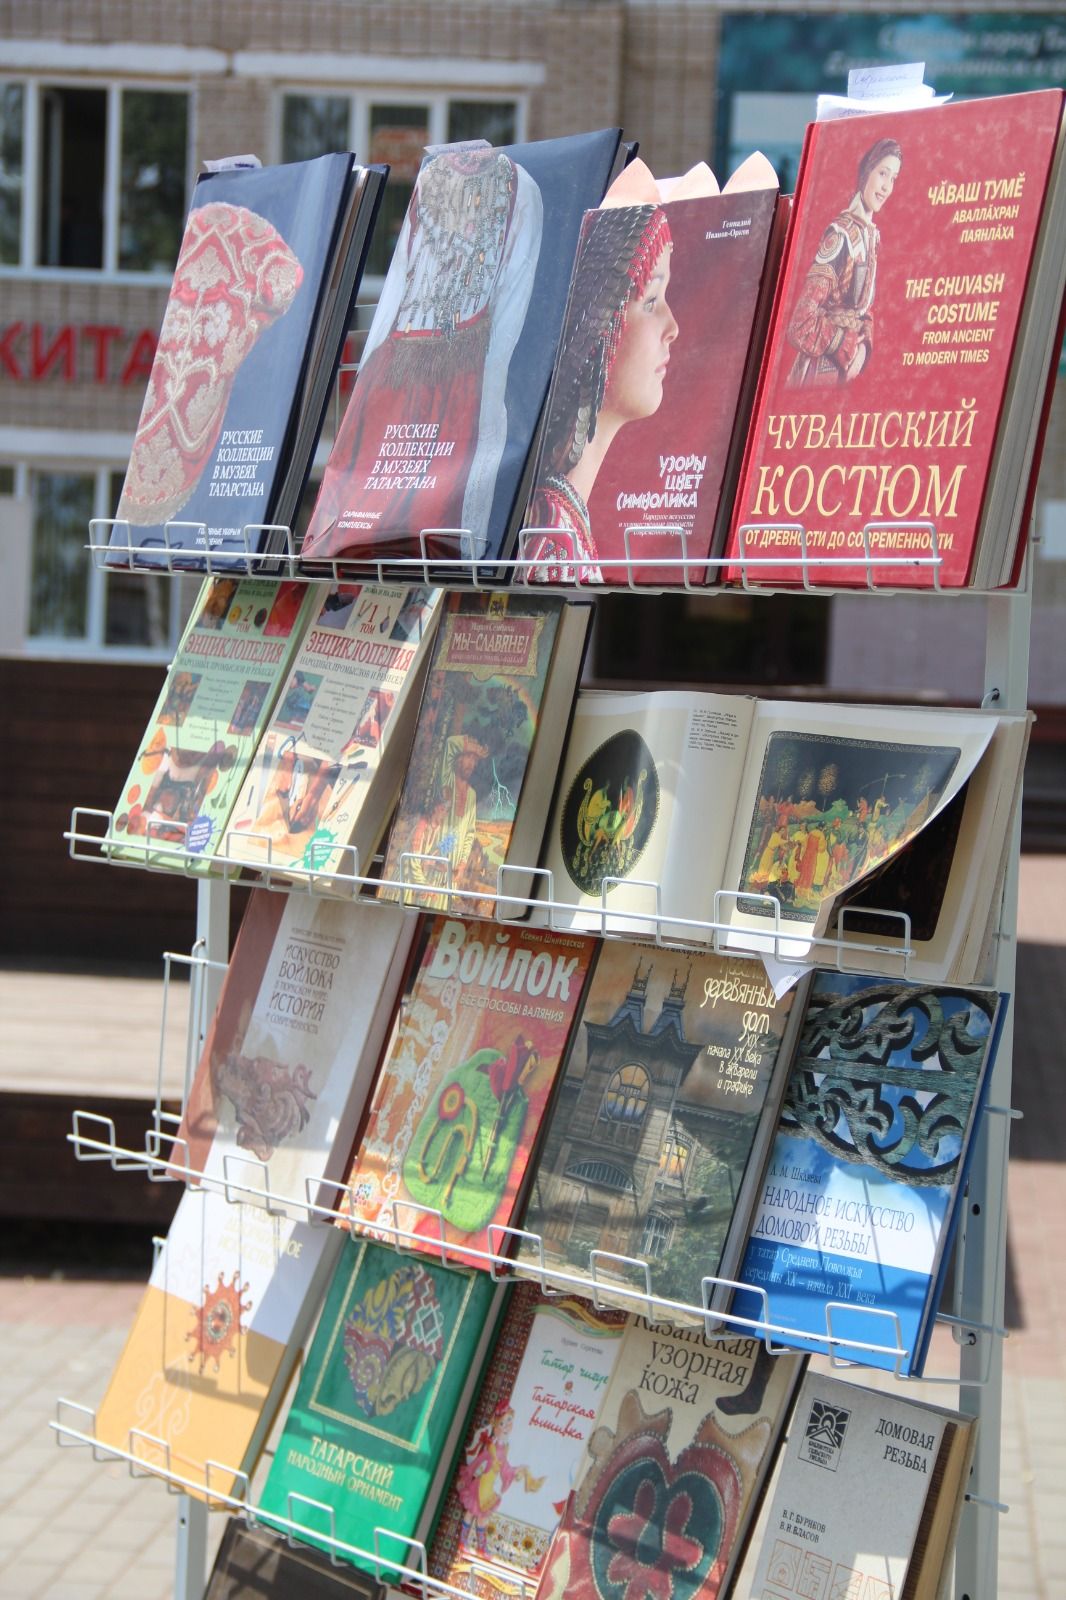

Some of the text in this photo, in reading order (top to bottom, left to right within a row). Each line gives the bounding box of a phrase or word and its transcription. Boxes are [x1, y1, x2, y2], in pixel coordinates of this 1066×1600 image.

[905, 273, 1005, 298] THE CHUVASH
[927, 301, 999, 324] COSTUME
[922, 328, 994, 345] FROM ANCIENT
[902, 349, 990, 366] TO MODERN TIMES
[384, 424, 439, 439] РУССКИЕ
[768, 398, 977, 449] ЧУВАШСКИЙ
[221, 430, 263, 445] РУССКИЕ
[379, 442, 455, 458] КОЛЛЕКЦИИ
[217, 447, 274, 463] КОЛЛЕКЦИИ
[371, 460, 431, 473] В МУЗЕЯХ
[659, 454, 707, 478] УЗОРЫ
[212, 465, 258, 479] В МУЗЕЯХ
[363, 476, 437, 490] ТАТАРСТАНА
[665, 472, 703, 492] ЦВЕТ
[209, 482, 264, 496] ТАТАРСТАНА
[616, 491, 698, 511] СИМВОЛИКА
[751, 464, 967, 518] КОСТЮМ
[745, 529, 758, 545] ОТ
[827, 531, 845, 549] ДО
[368, 604, 378, 623] 1
[359, 623, 376, 635] ТОМ
[184, 633, 286, 665] ЭНЦИКЛОПЕДИЯ
[305, 631, 415, 671] ЭНЦИКЛОПЕДИЯ
[285, 944, 340, 969] ИСКУССТВО
[279, 960, 333, 990] ВОЙЛОКА
[269, 991, 325, 1021] ИСТОРИЯ
[477, 996, 521, 1015] СПОСОБЫ
[522, 1004, 565, 1023] ВАЛЯНИЯ
[738, 1011, 770, 1041] дом
[707, 1045, 731, 1058] начала
[763, 1186, 915, 1233] НАРОДНОЕ ИСКУССТВО
[756, 1215, 872, 1255] ДОМОВОЙ РЕЗЬБЫ
[781, 1247, 819, 1270] Среднего
[821, 1255, 863, 1280] Поволжья
[784, 1270, 798, 1287] XX
[806, 1281, 834, 1297] начала
[856, 1291, 876, 1305] века
[646, 1341, 749, 1386] узорная
[638, 1369, 700, 1405] кожа
[531, 1386, 596, 1419] Татарская
[874, 1418, 935, 1451] ДОМОВАЯ
[310, 1435, 394, 1489] ТАТАРСКИЙ
[883, 1445, 928, 1474] РЕЗЬБА
[287, 1449, 403, 1512] НАРОДНЫЙ ОРНАМЕНТ
